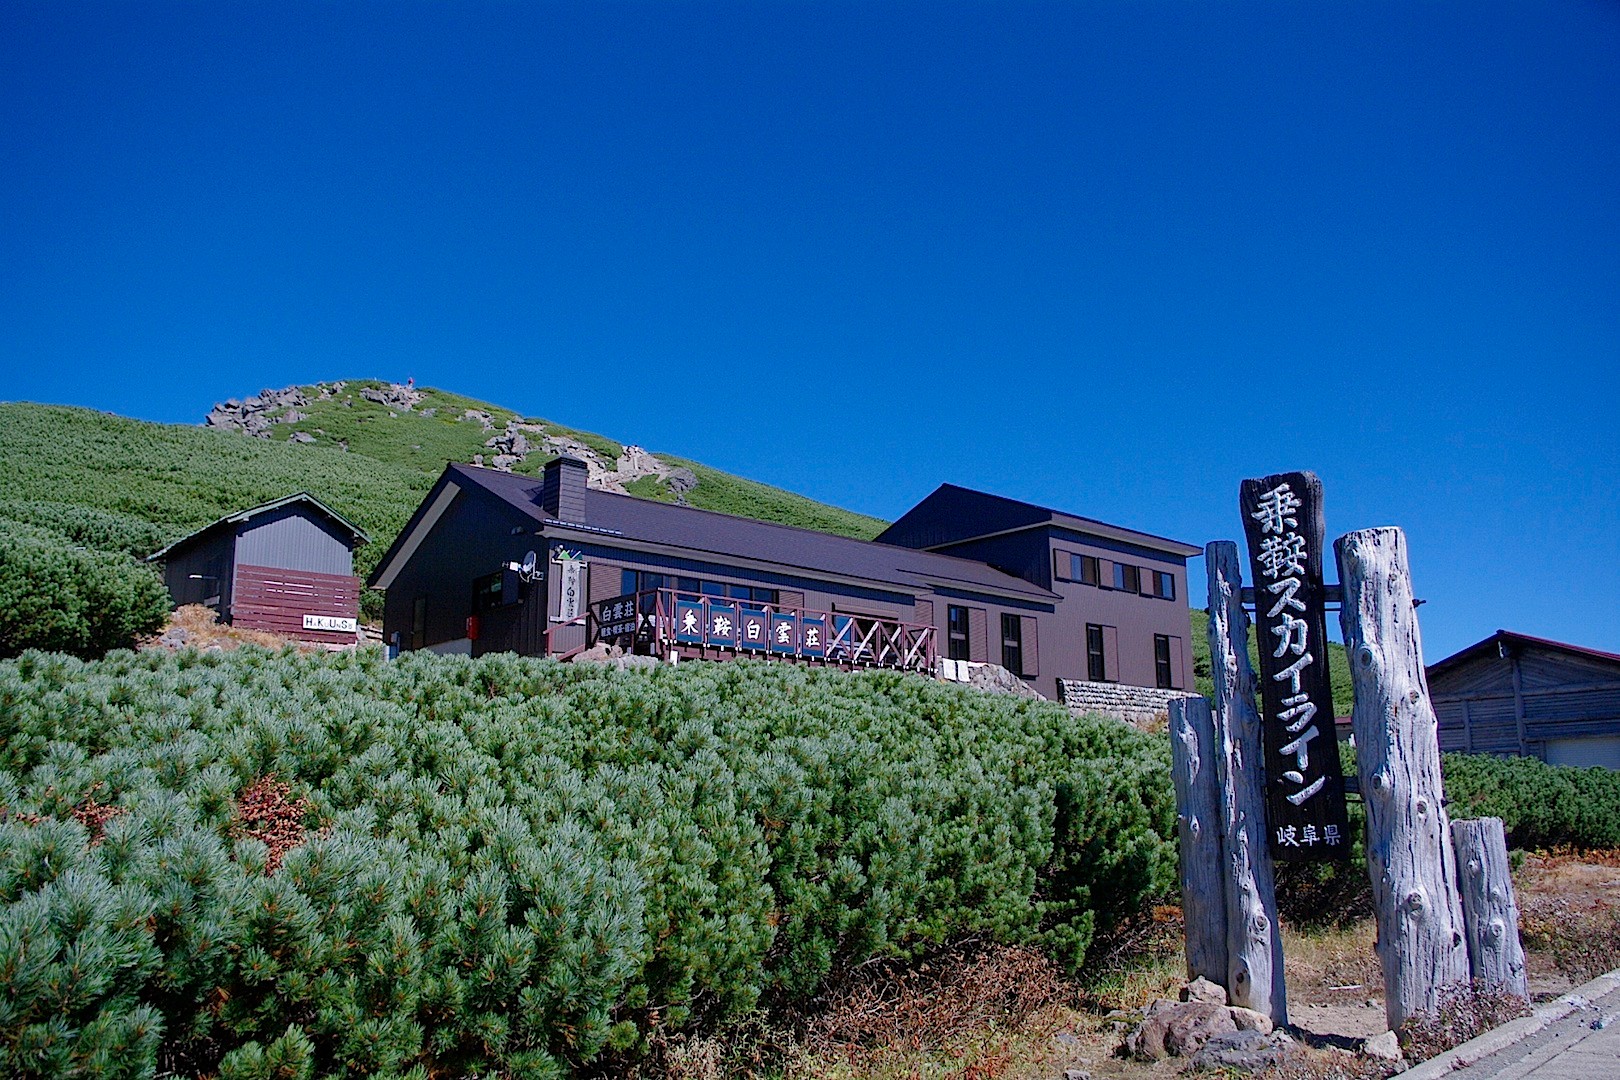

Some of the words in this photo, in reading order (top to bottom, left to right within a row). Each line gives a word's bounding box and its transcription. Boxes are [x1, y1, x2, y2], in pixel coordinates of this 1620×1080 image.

[602, 600, 634, 621] 白雲荘
[680, 608, 821, 648] 乗鞍白雲荘
[1251, 483, 1326, 806] 乗鞍スカイライン
[1275, 823, 1341, 847] 岐阜県
